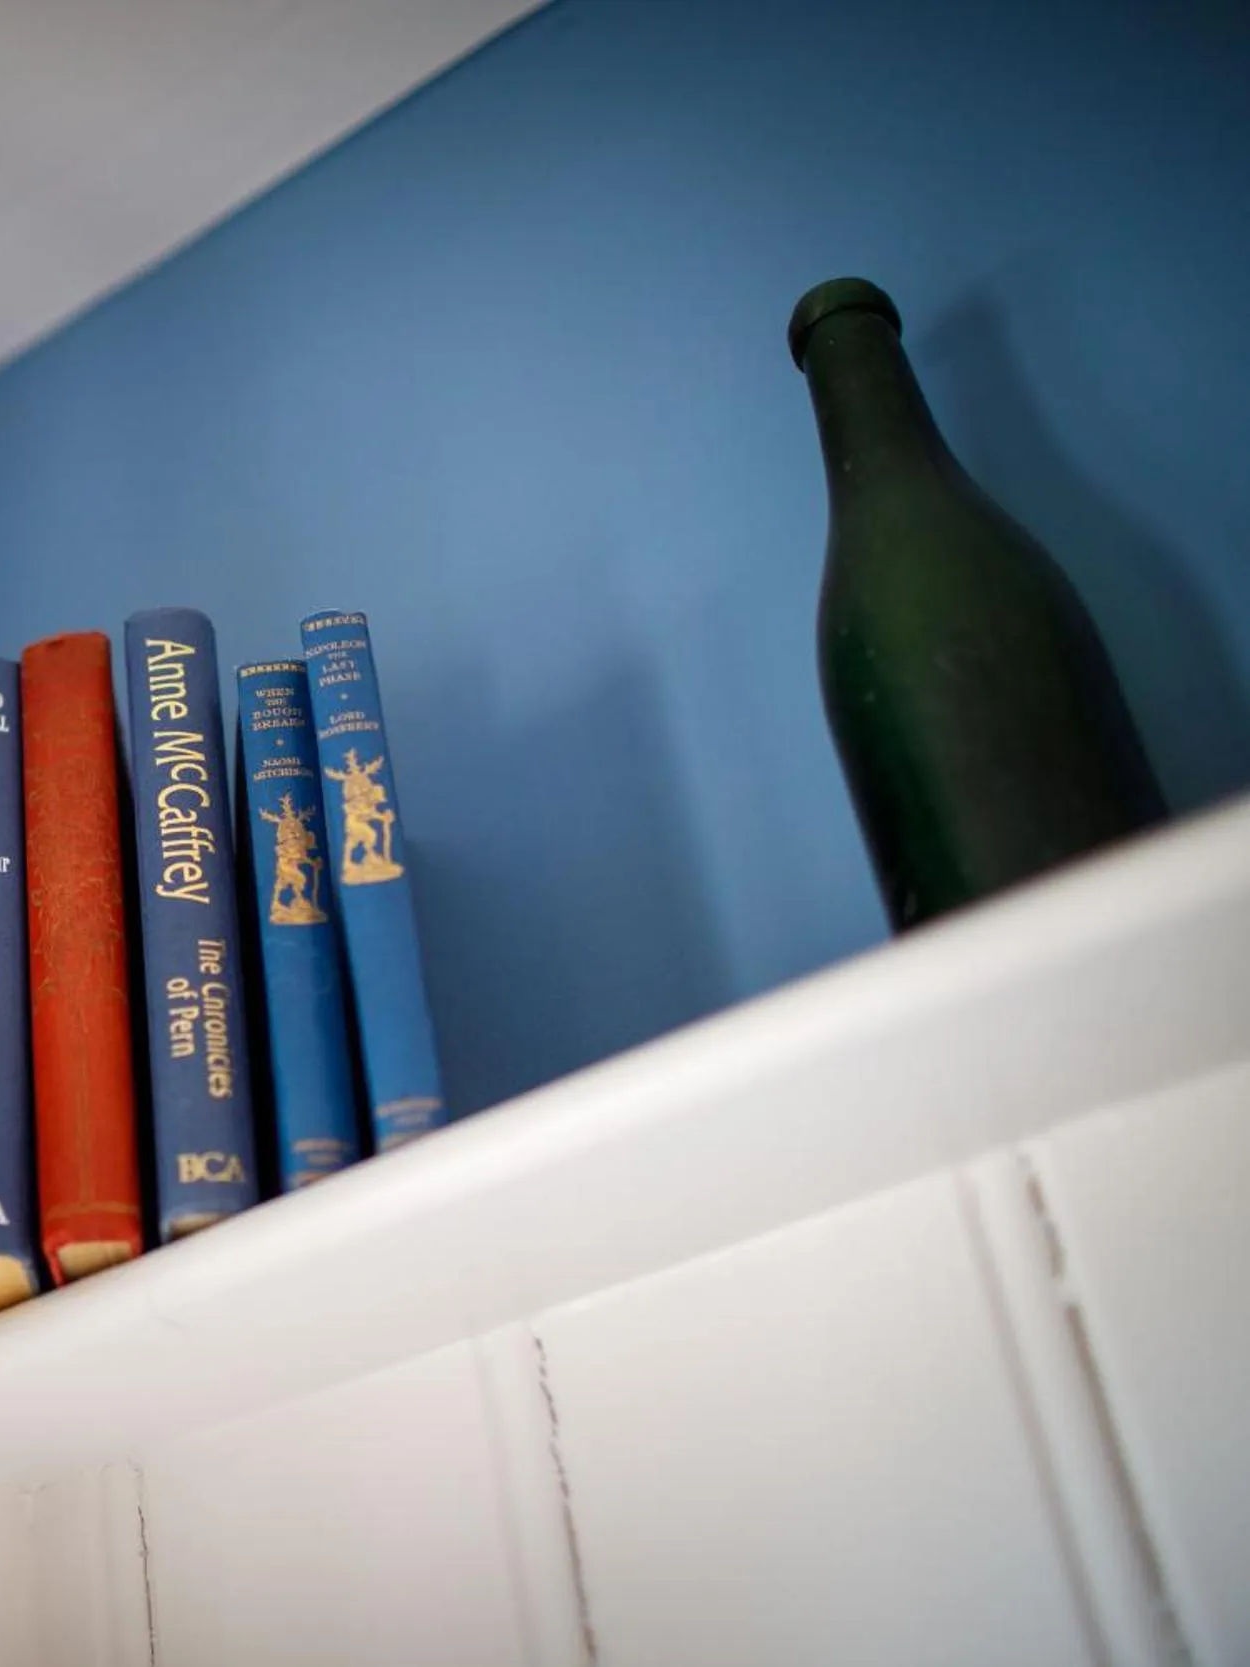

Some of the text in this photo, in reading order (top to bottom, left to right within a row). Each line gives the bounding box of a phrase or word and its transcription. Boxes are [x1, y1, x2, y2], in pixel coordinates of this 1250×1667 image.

[319, 671, 362, 687] PHASE
[322, 660, 356, 675] LAST
[145, 638, 215, 904] Anne McCaffrey
[198, 938, 226, 976] The
[166, 977, 200, 1059] of Pern
[177, 1151, 246, 1183] BCA
